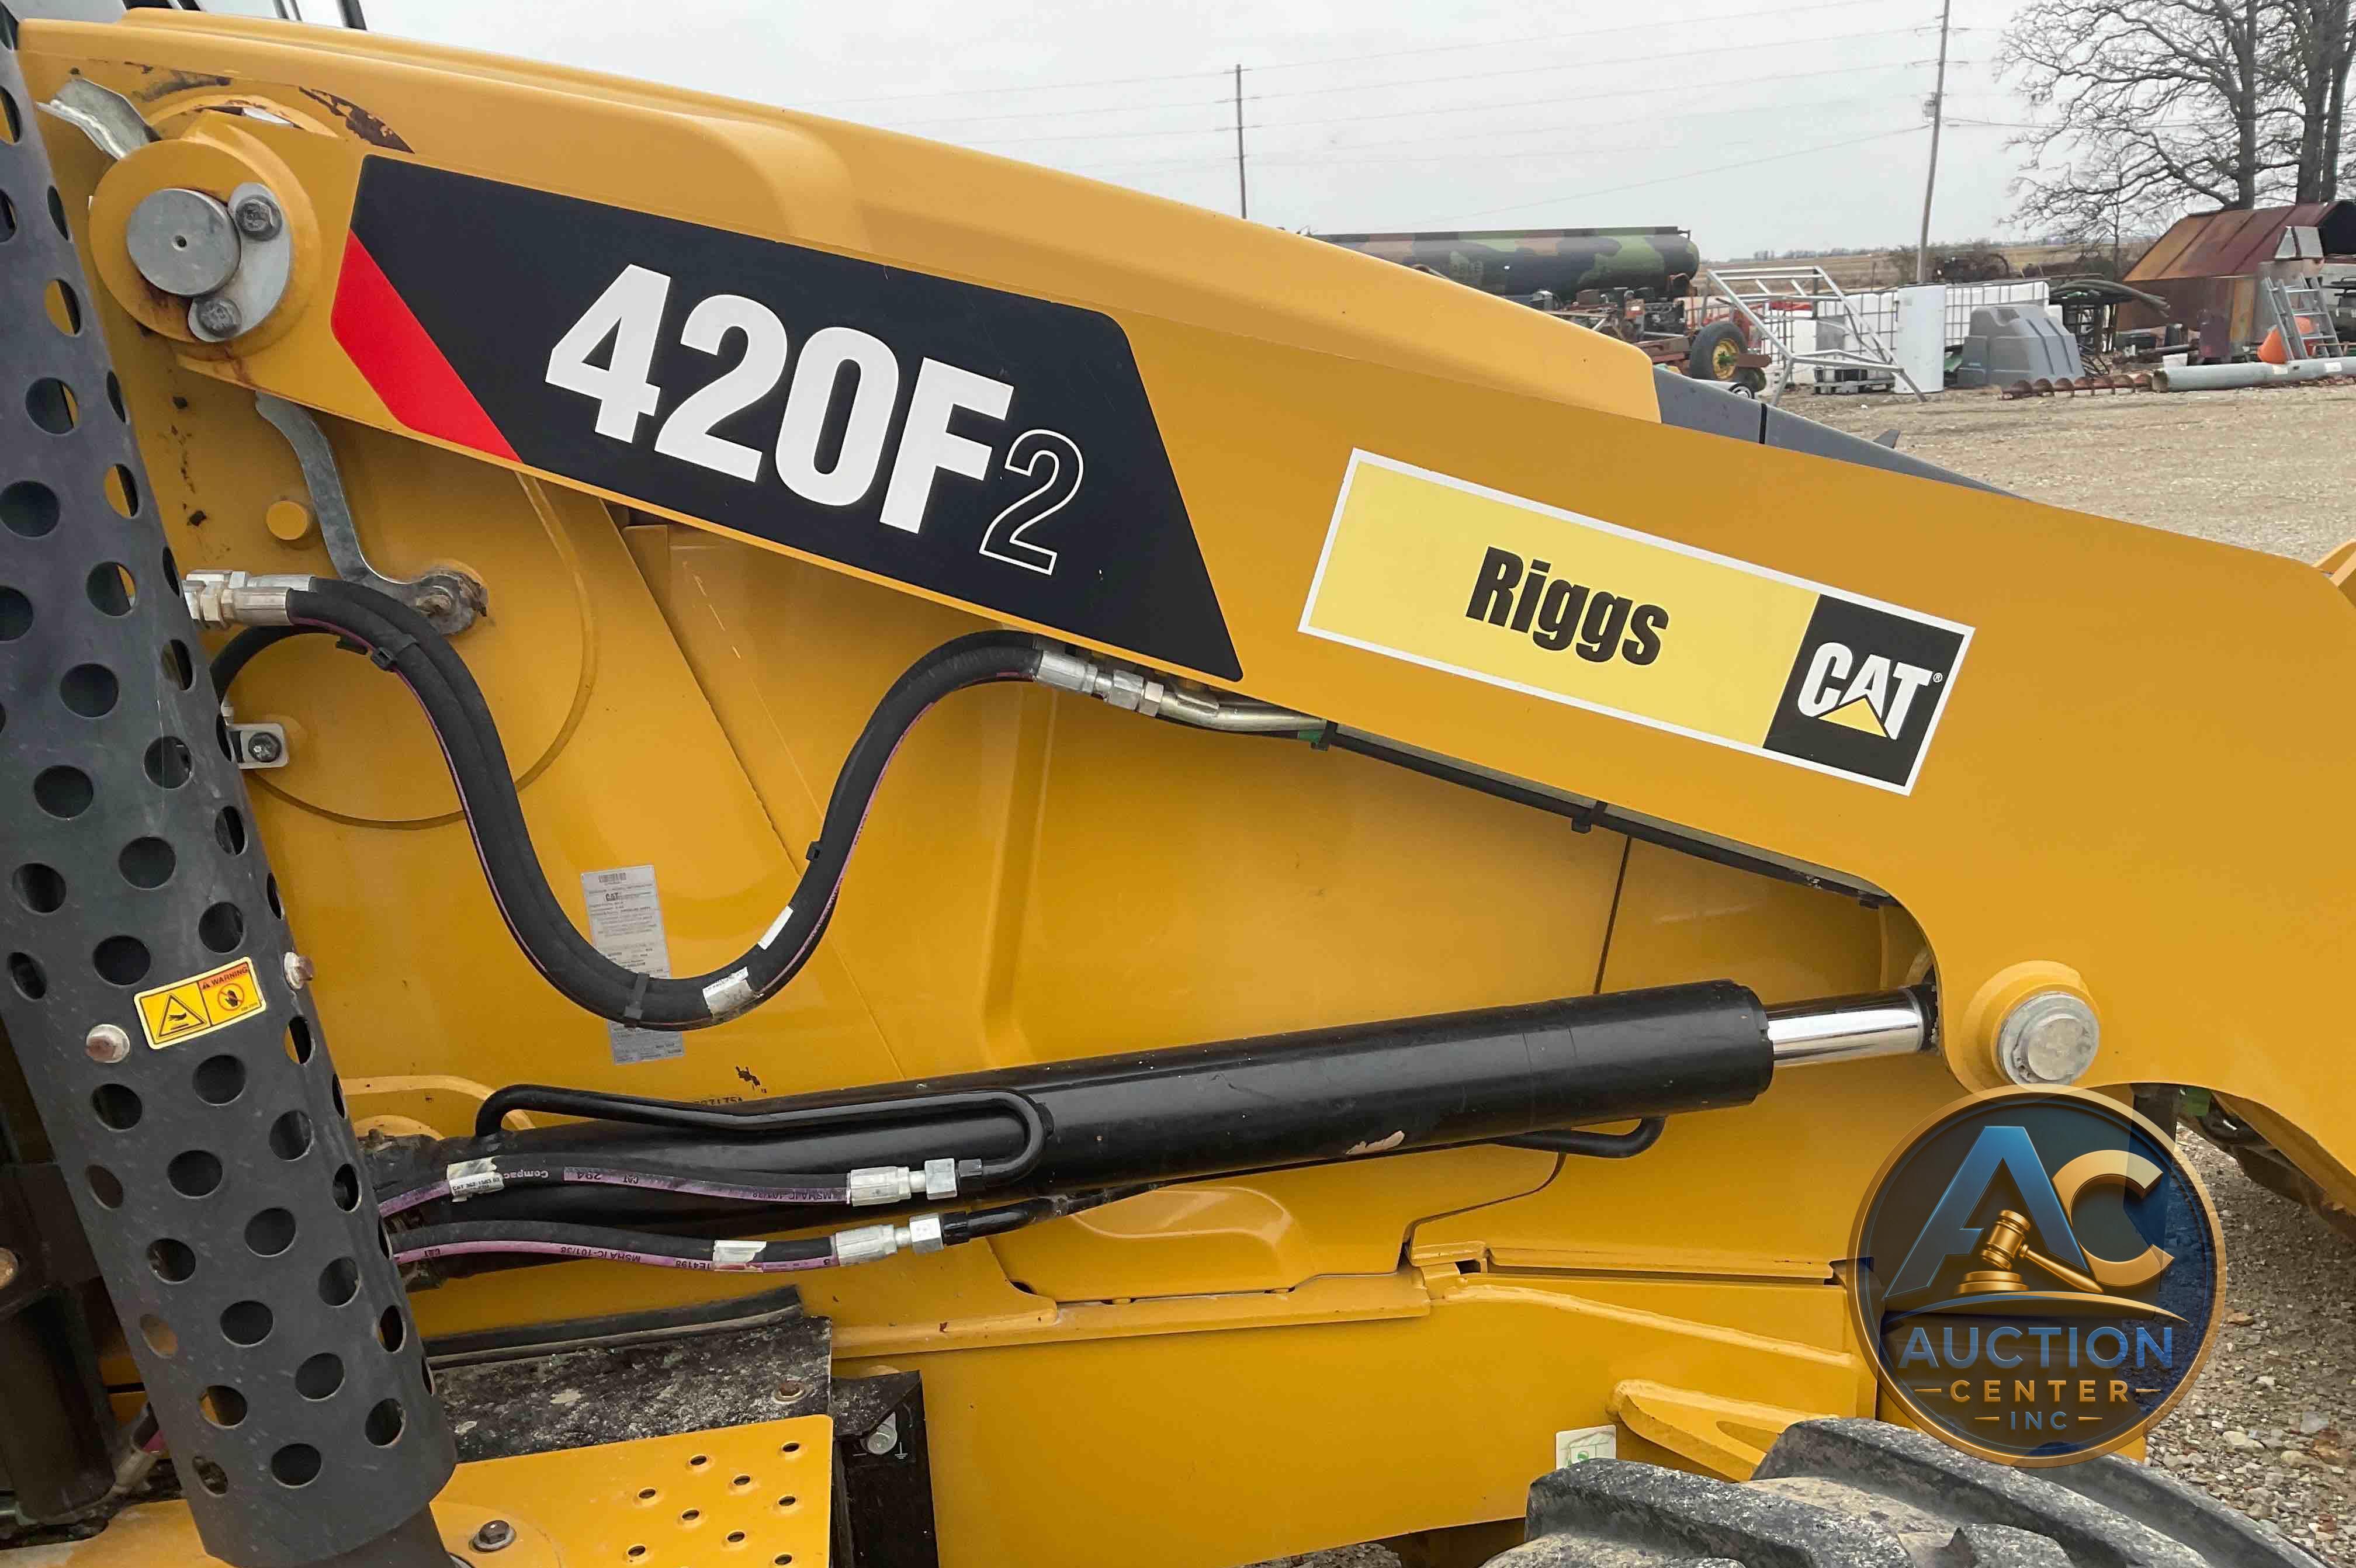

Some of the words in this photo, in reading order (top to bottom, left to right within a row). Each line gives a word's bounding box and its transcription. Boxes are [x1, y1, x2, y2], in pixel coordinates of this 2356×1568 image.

[1465, 546, 1669, 666] Riggs
[211, 966, 249, 986] WARNING
[610, 1252, 641, 1263] MSHA
